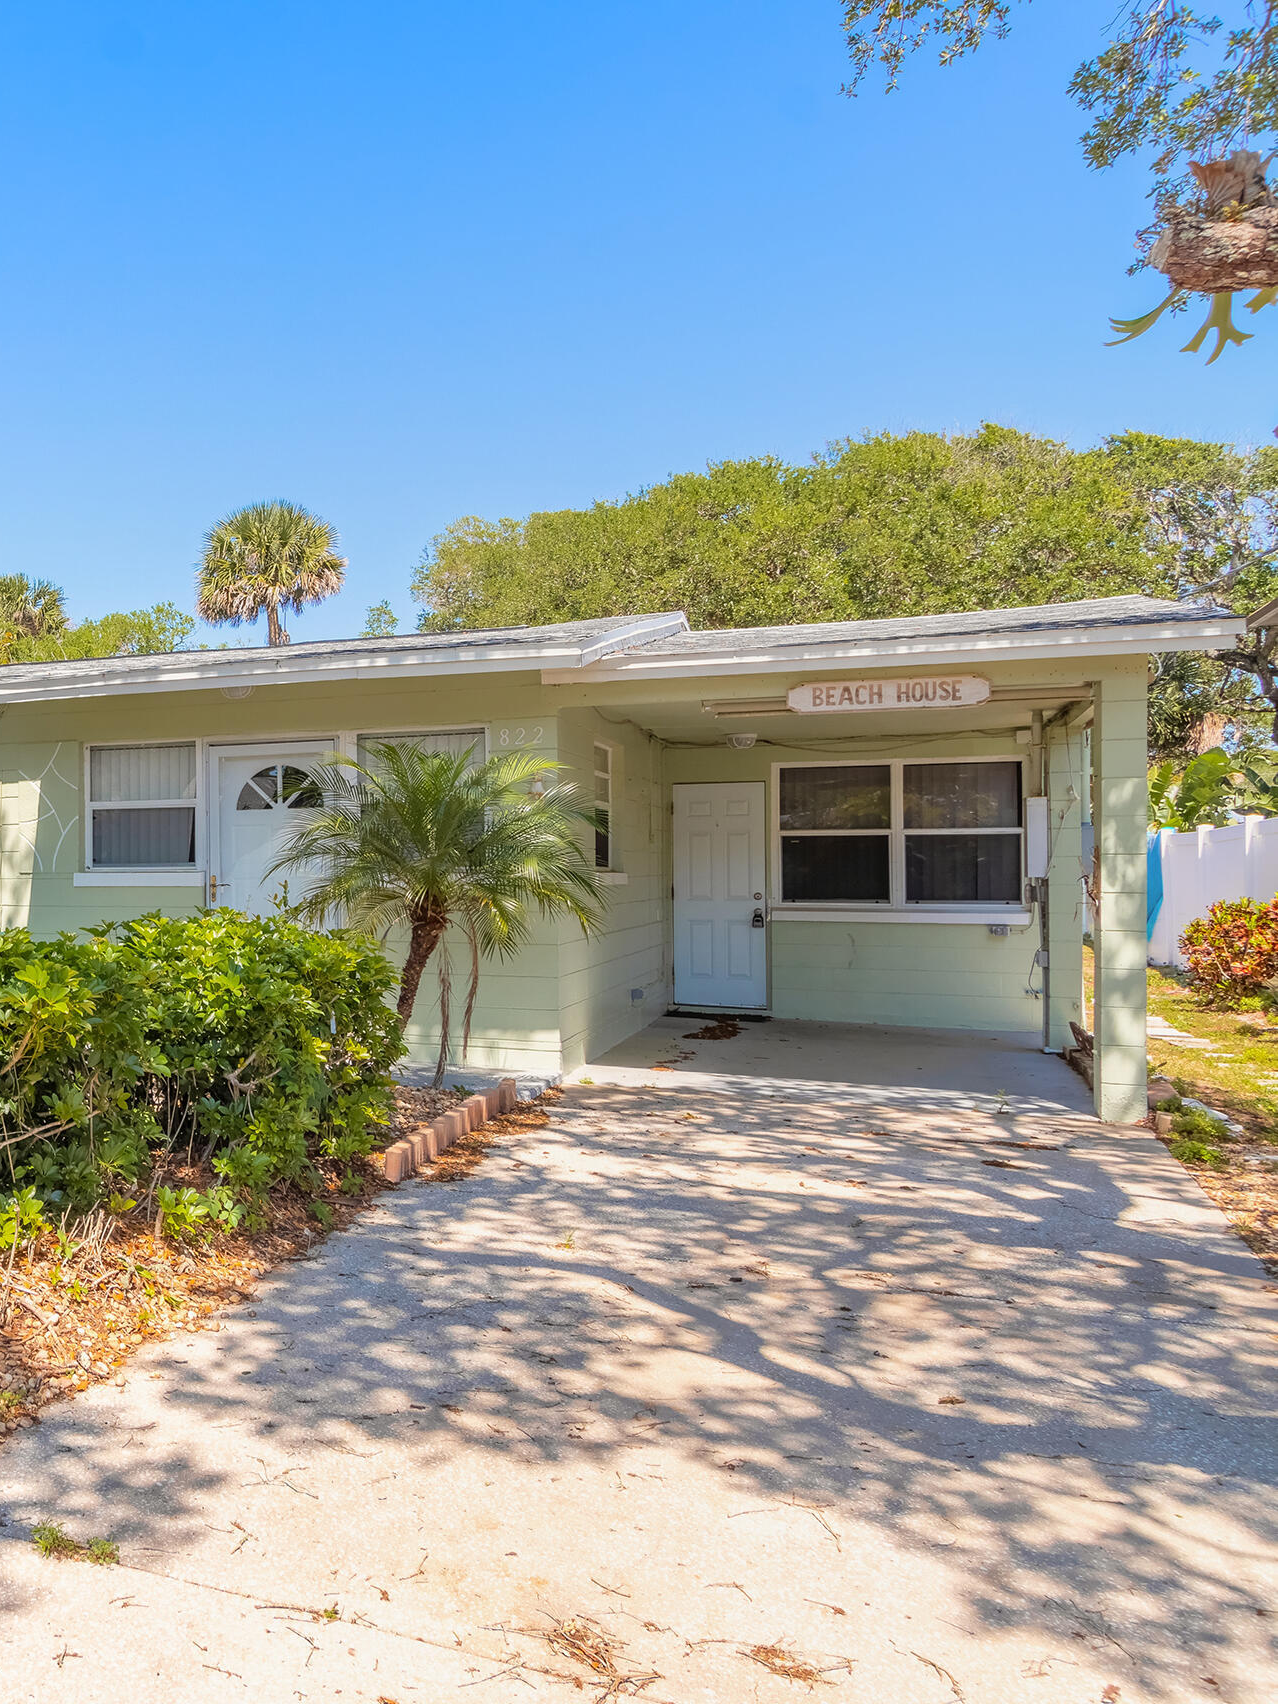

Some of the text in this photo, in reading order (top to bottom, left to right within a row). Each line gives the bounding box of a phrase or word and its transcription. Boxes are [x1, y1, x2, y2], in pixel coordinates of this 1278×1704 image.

[811, 680, 963, 707] BEACH HOUSE
[499, 727, 543, 745] 822
